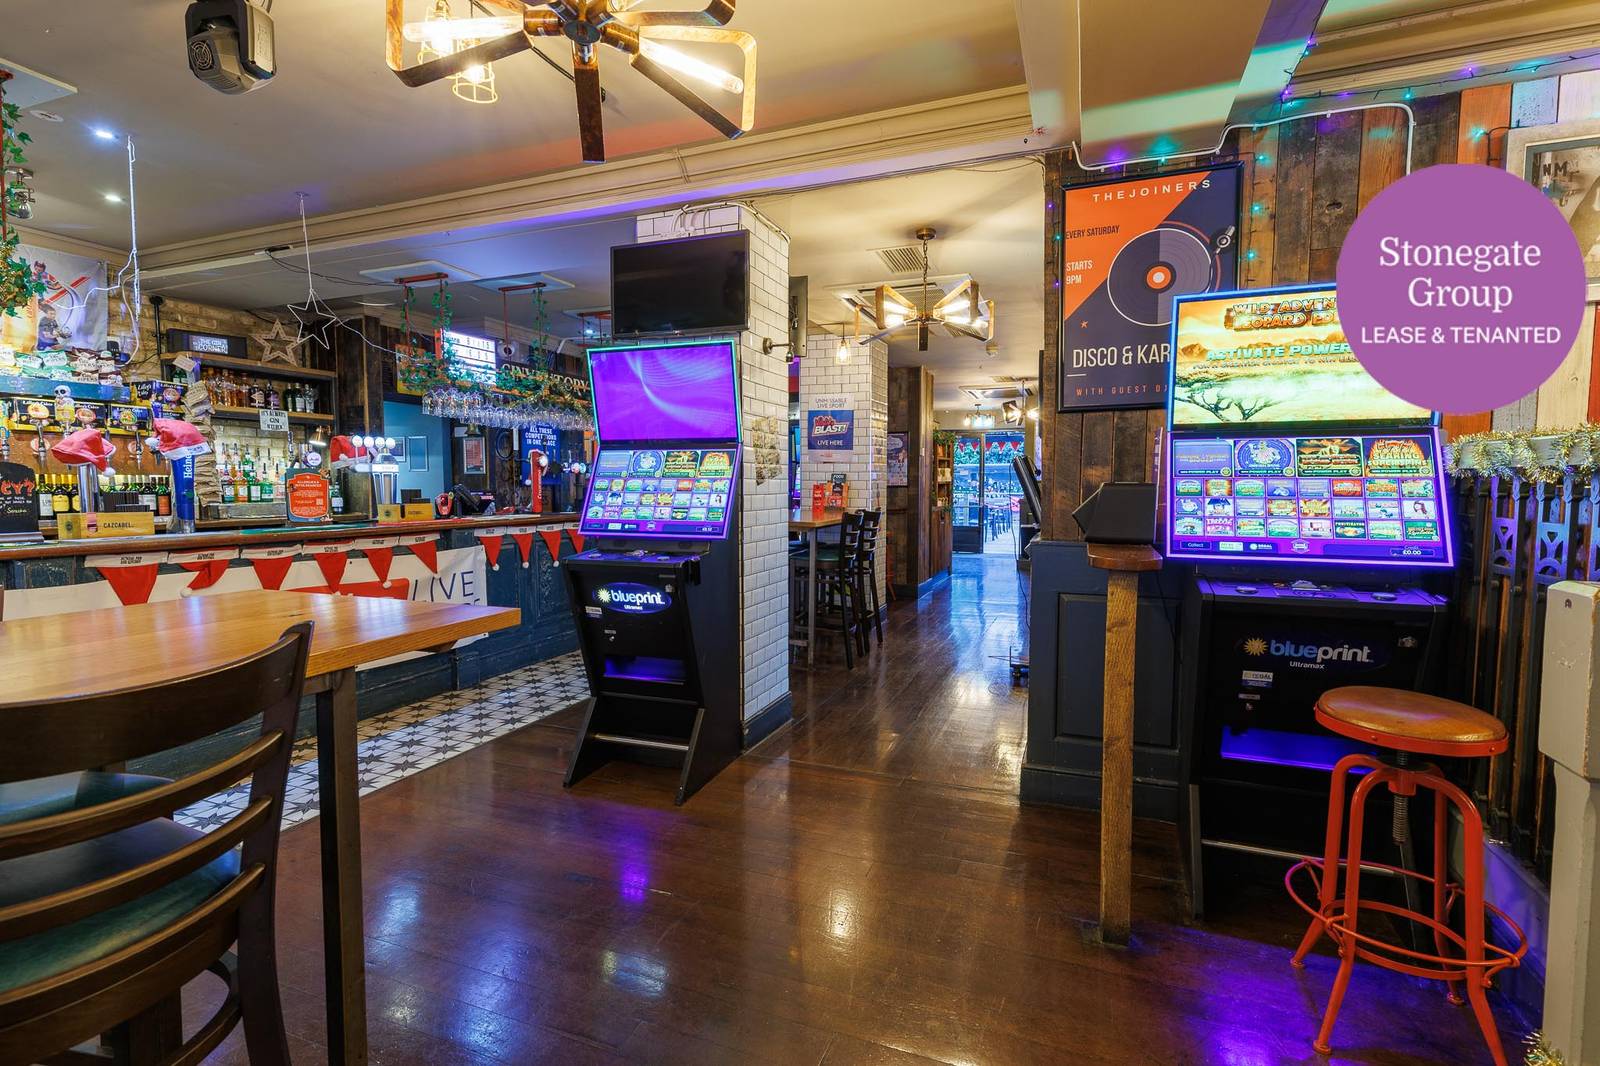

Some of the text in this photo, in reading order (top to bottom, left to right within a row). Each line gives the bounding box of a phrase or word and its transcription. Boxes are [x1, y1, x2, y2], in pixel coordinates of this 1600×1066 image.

[1065, 225, 1120, 240] EVERY SATURDAY
[1066, 259, 1093, 272] STARTS
[1066, 274, 1082, 285] 9PM
[1233, 303, 1271, 315] WILD
[1072, 343, 1170, 368] DISCO & KAR
[1206, 343, 1351, 361] ACTIVATE POWER
[1076, 388, 1104, 396] WITH
[1112, 386, 1146, 395] GUEST
[525, 432, 557, 440] COMPETIONS
[814, 425, 846, 434] BLAST!
[412, 570, 474, 602] LIVE
[611, 589, 663, 606] blueprint
[1269, 639, 1370, 663] blueprint
[1289, 660, 1325, 670] Ultramax
